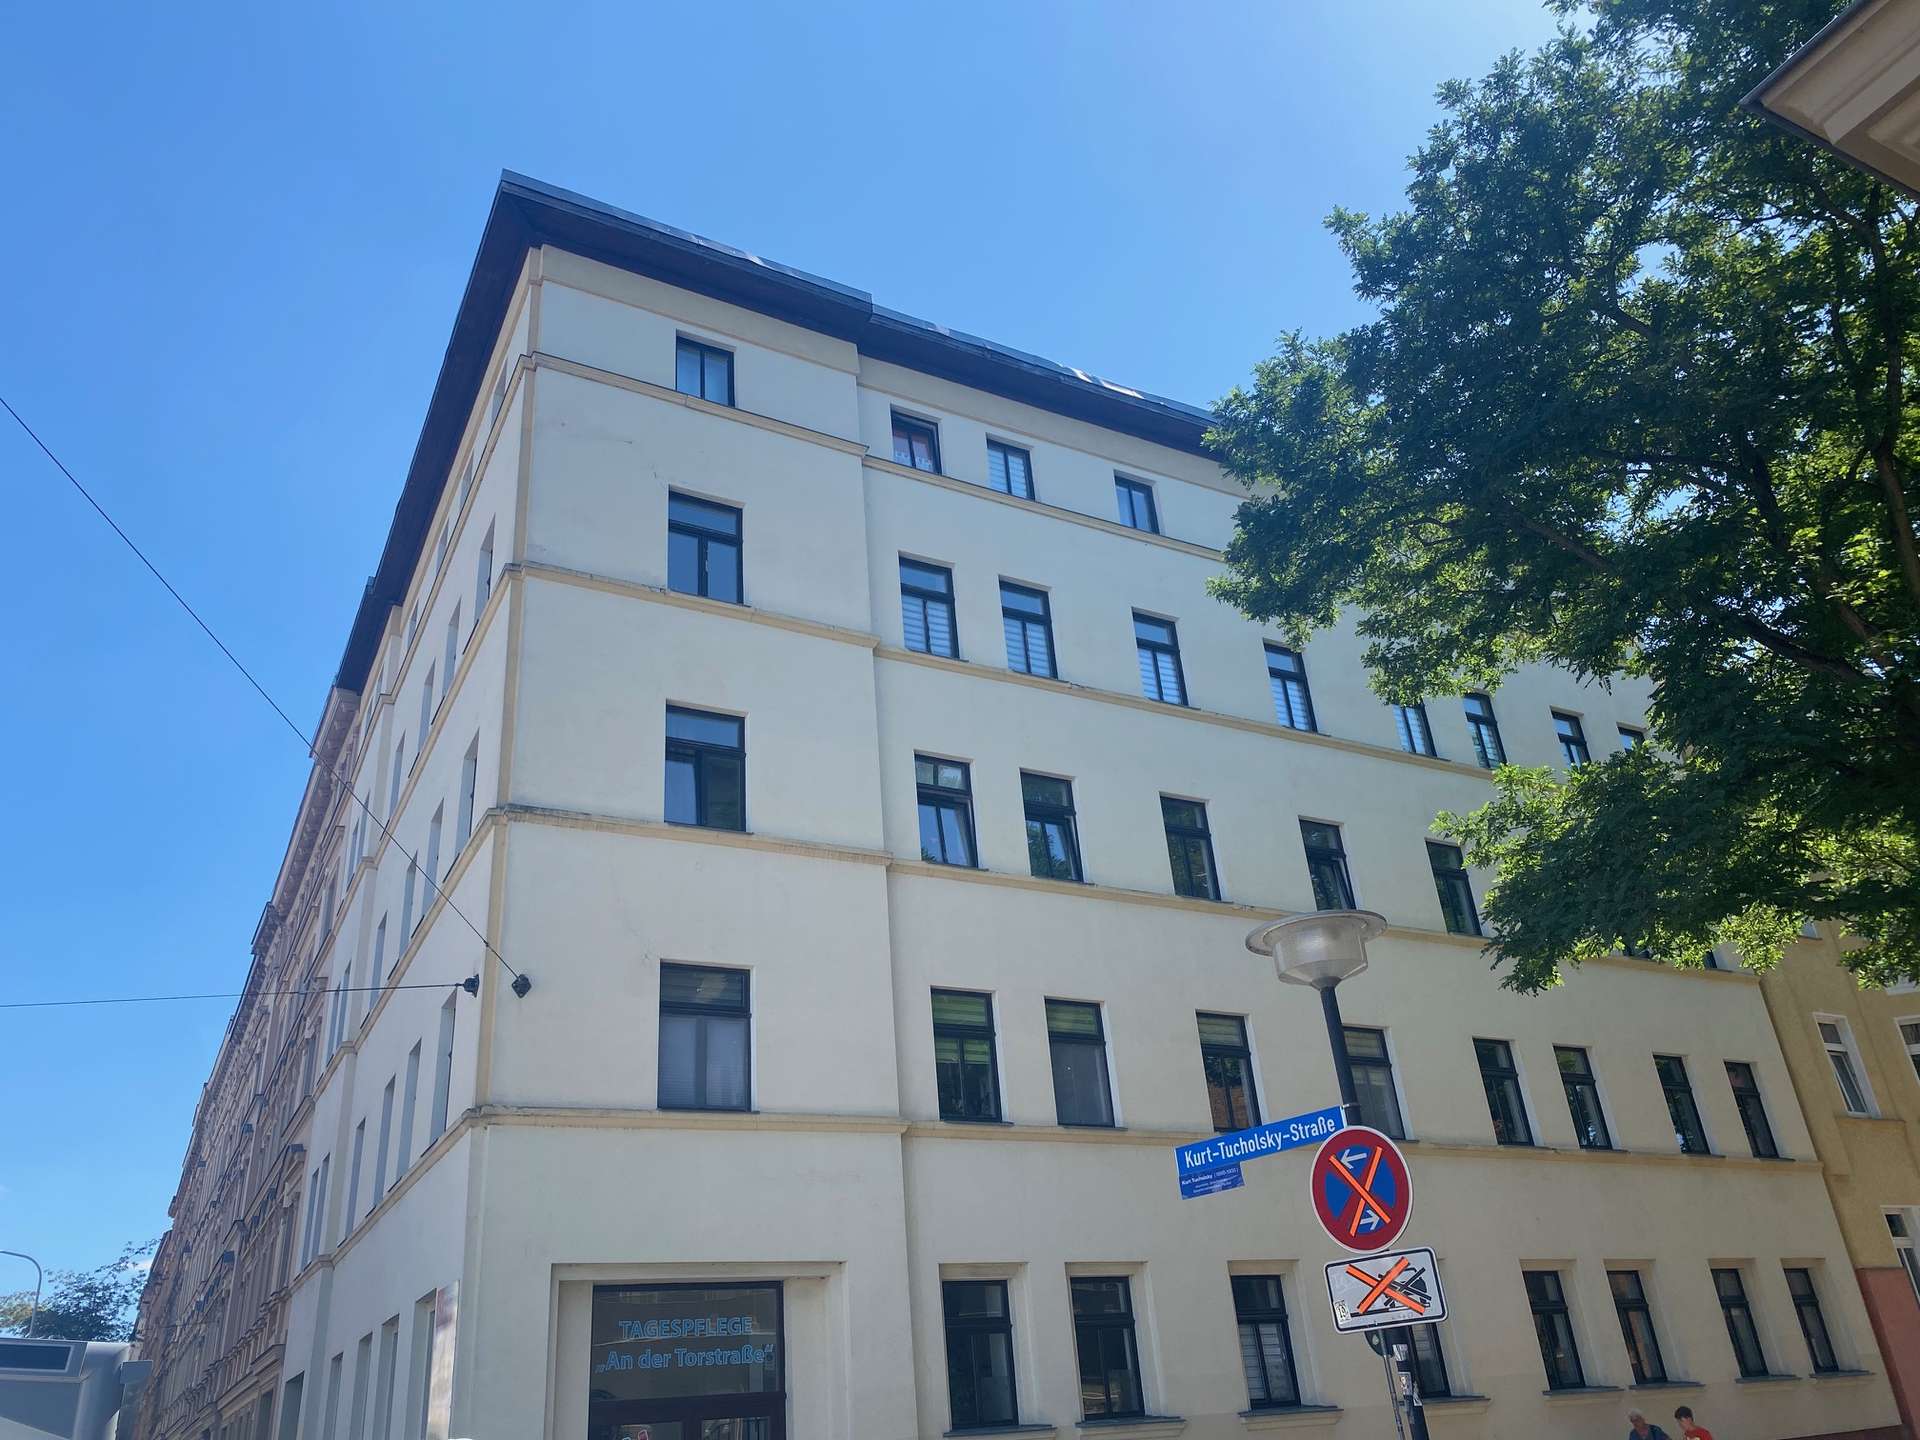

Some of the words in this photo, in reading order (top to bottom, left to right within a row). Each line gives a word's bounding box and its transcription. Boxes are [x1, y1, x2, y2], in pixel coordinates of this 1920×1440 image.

[1185, 1116, 1336, 1169] Kurt-Tucholsky-Straße
[618, 1316, 753, 1340] TAGESPFLEGE
[637, 1349, 672, 1369] der
